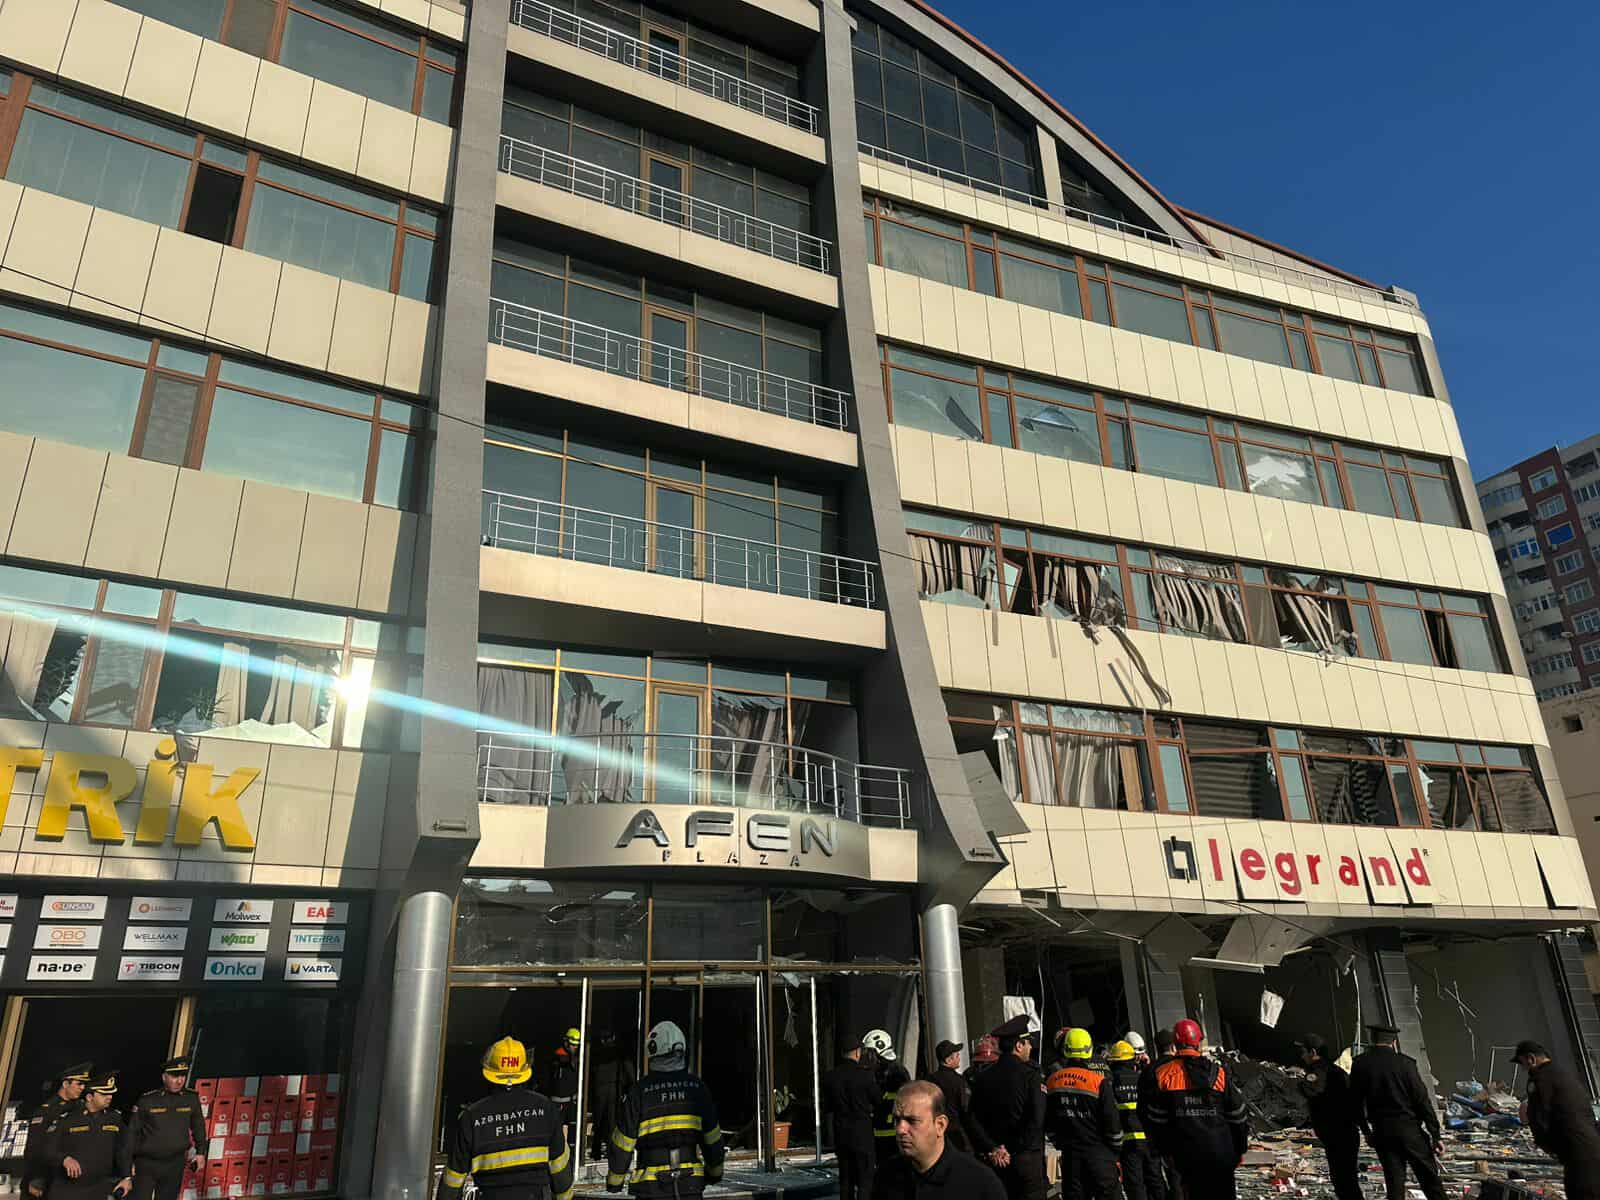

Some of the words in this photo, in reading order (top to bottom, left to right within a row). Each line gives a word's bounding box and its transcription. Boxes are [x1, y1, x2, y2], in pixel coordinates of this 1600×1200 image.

[615, 808, 837, 857] AFEN
[661, 850, 800, 867] PLAZA
[1208, 838, 1431, 895] legrand
[224, 911, 261, 920] Molwex
[306, 906, 336, 918] EAE
[51, 930, 86, 940] OBO
[133, 933, 179, 941] WELLMAX
[221, 933, 256, 945] WAGO
[139, 963, 180, 971] TIBCON
[210, 961, 257, 976] Onka
[302, 965, 337, 973] VARTA
[501, 1056, 519, 1068] FHN
[660, 1091, 686, 1102] FHN
[495, 1121, 526, 1137] FHN
